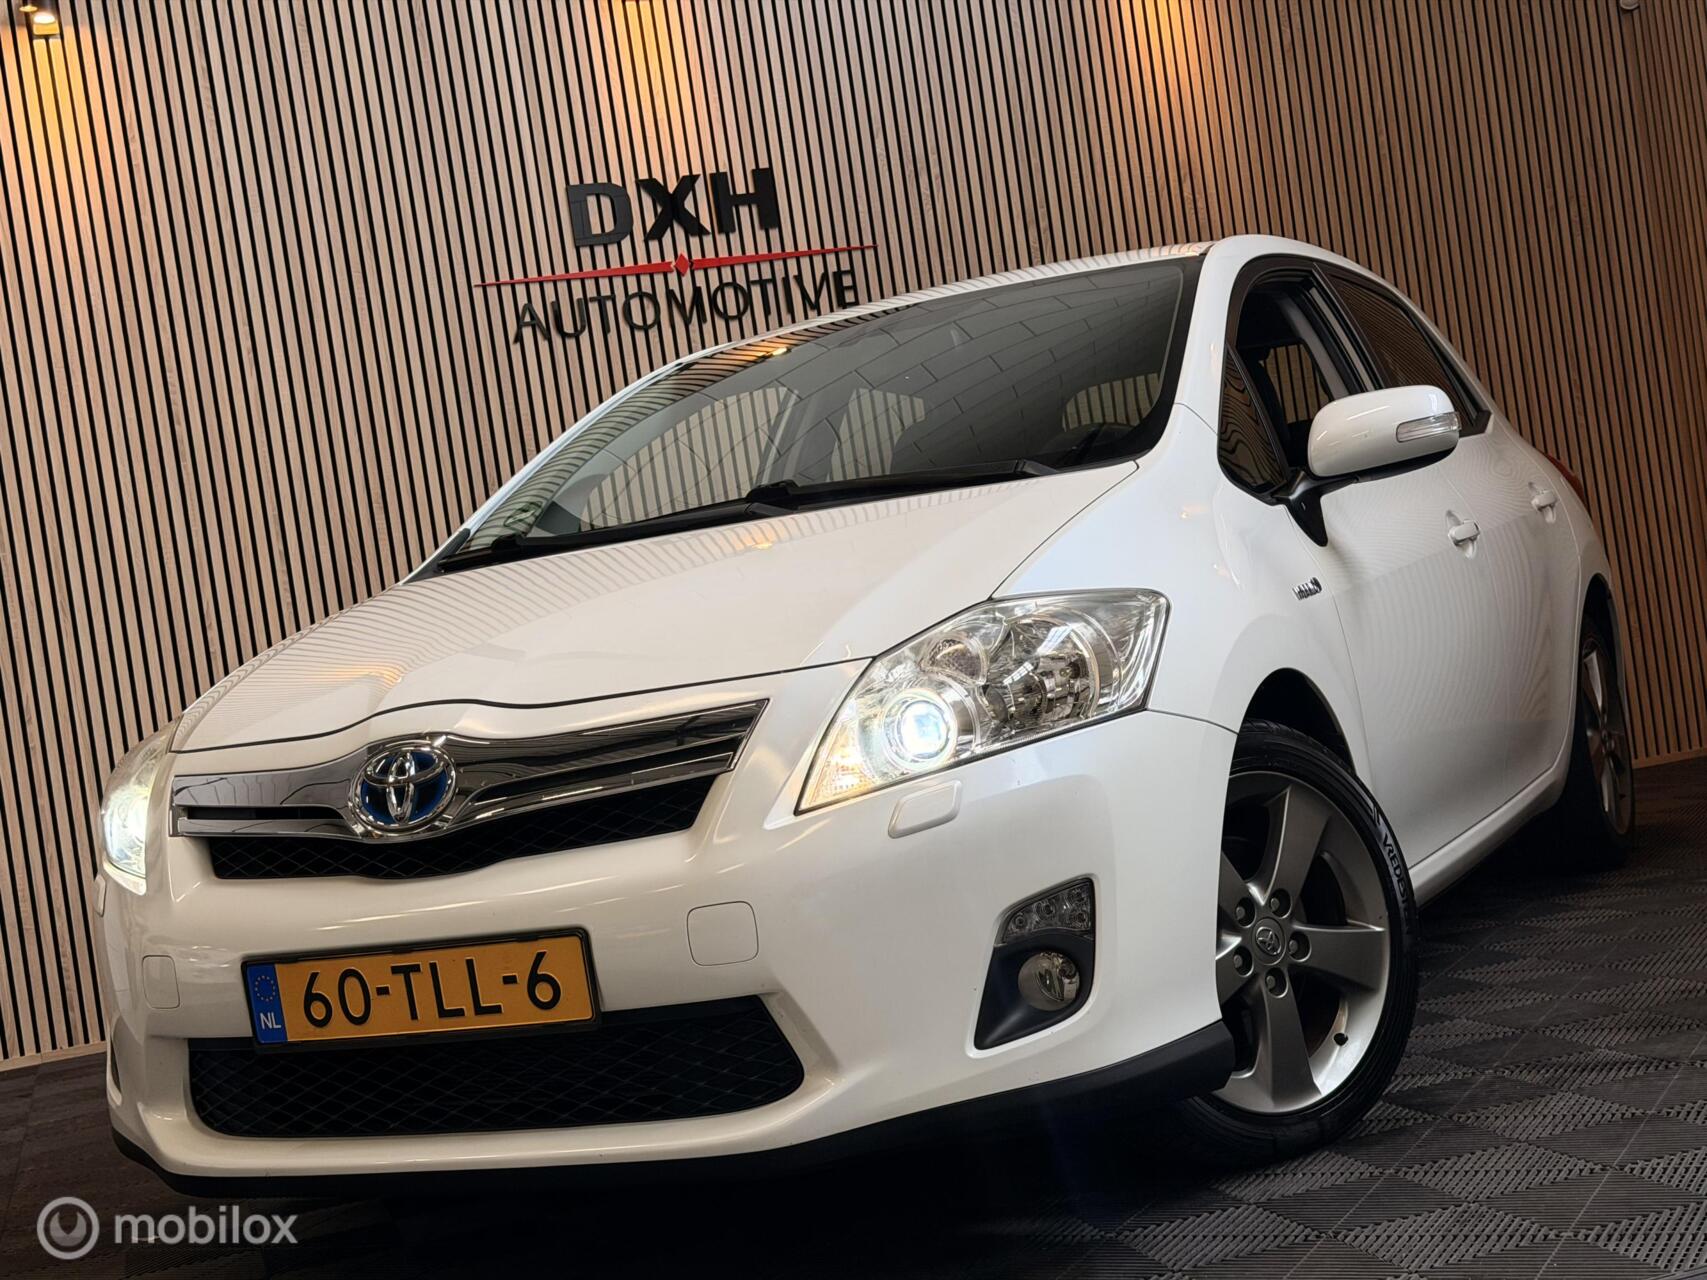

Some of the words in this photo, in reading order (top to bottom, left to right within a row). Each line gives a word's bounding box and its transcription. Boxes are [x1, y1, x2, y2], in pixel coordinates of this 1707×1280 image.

[566, 167, 781, 247] DXH
[513, 268, 861, 345] AUTOMOTIVE
[260, 1012, 281, 1030] NL
[303, 951, 562, 1029] 60-TLL-6
